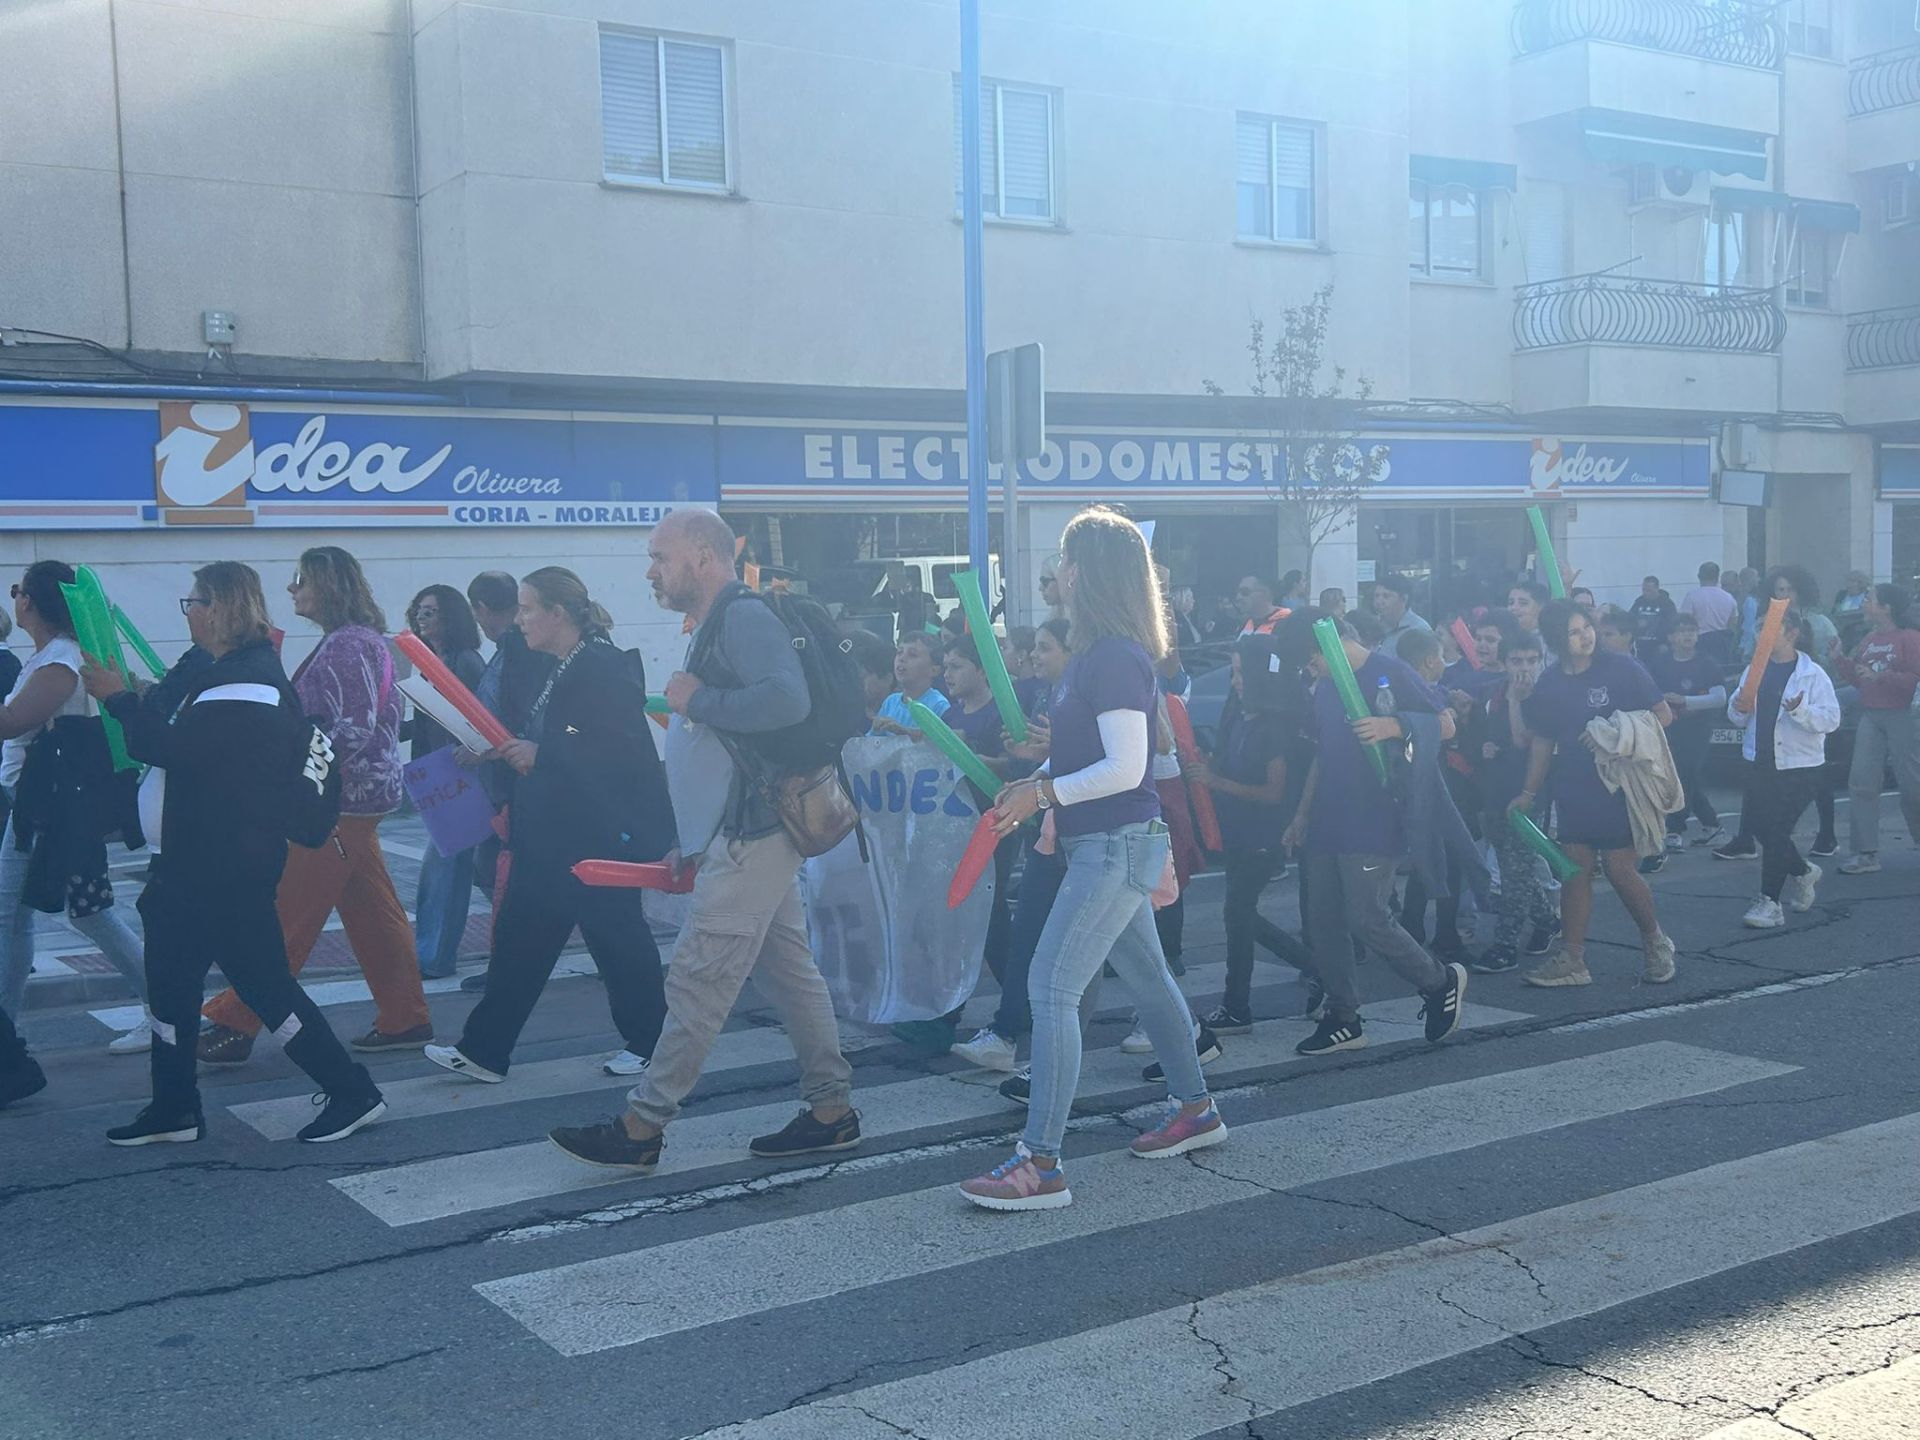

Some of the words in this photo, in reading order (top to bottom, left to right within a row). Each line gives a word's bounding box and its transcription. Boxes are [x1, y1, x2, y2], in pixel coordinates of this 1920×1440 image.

[155, 404, 452, 506] idea
[453, 466, 562, 494] Olivera
[803, 434, 1391, 482] ELECTODOMESTICOS
[1530, 439, 1629, 489] idea
[454, 506, 530, 523] CORIA
